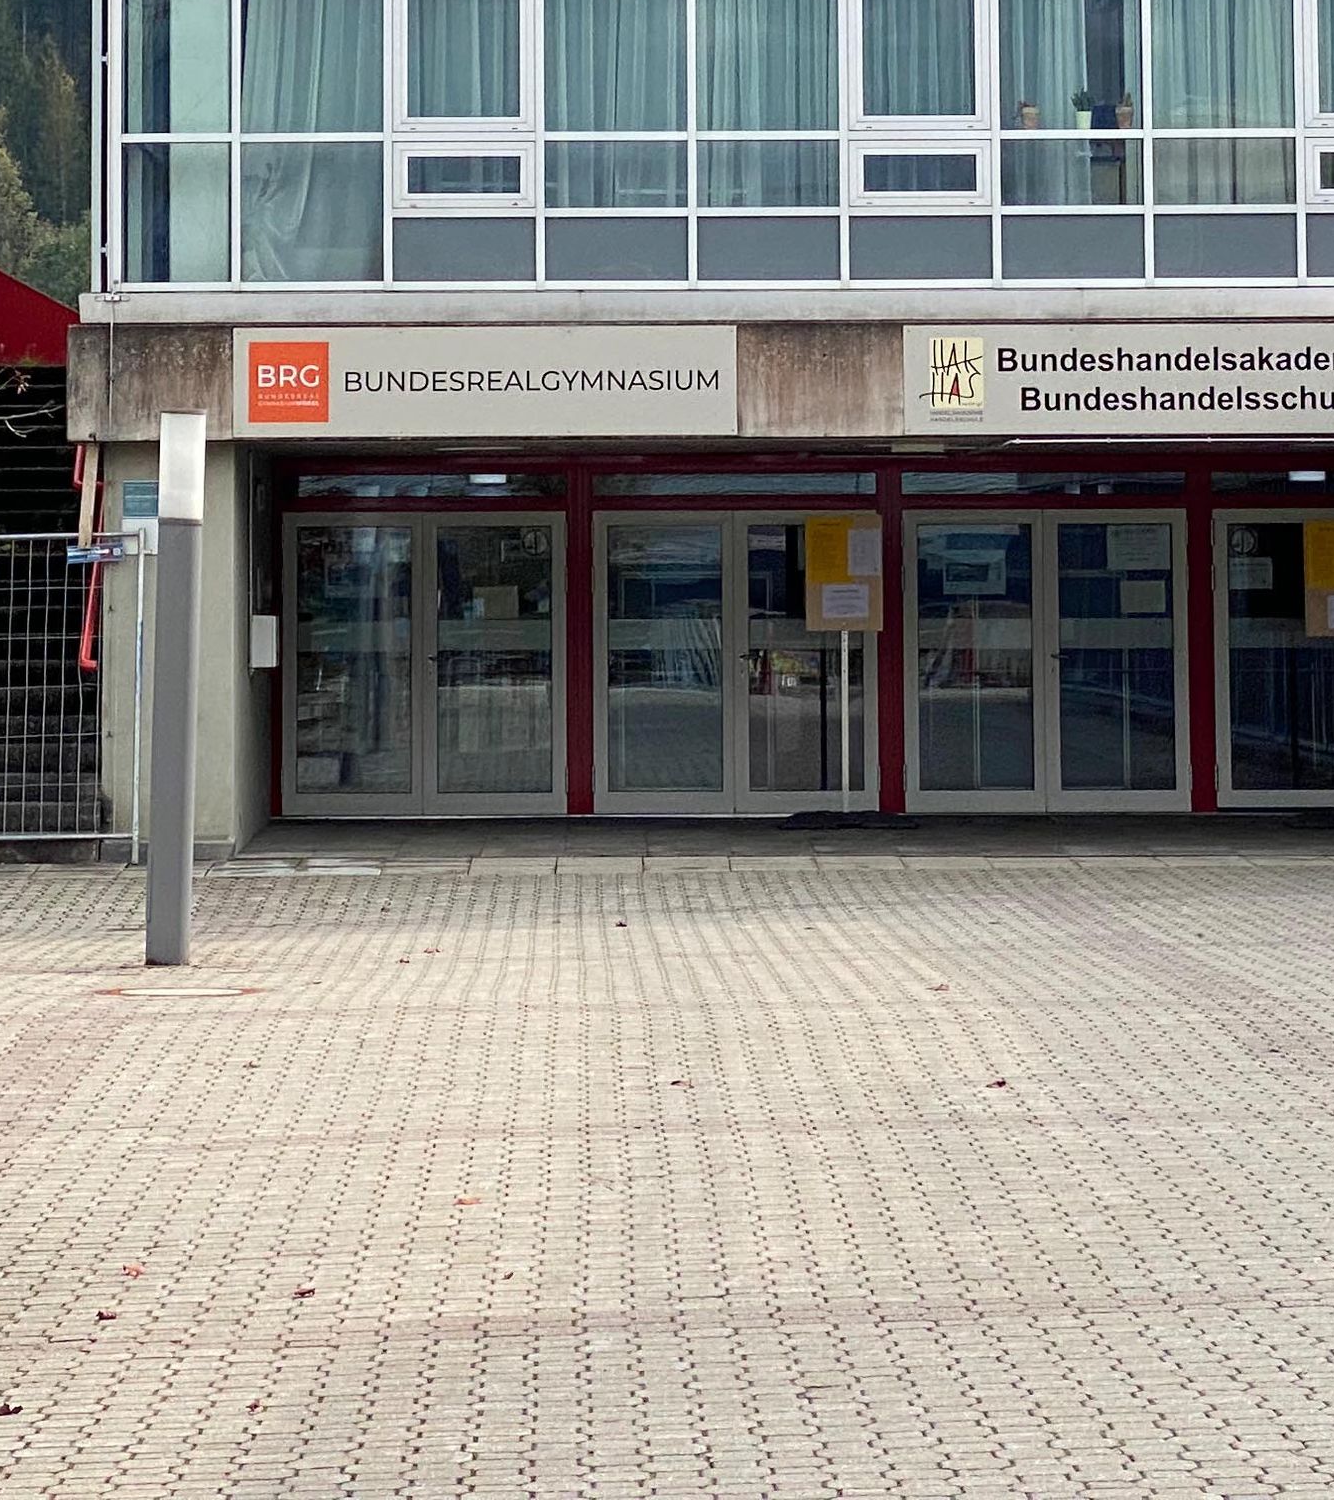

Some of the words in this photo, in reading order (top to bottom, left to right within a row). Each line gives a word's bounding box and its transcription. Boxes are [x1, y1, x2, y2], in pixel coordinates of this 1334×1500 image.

[930, 339, 983, 376] HAK
[257, 364, 320, 388] BRG
[343, 369, 720, 392] BUNDESREALGYMNASIUM
